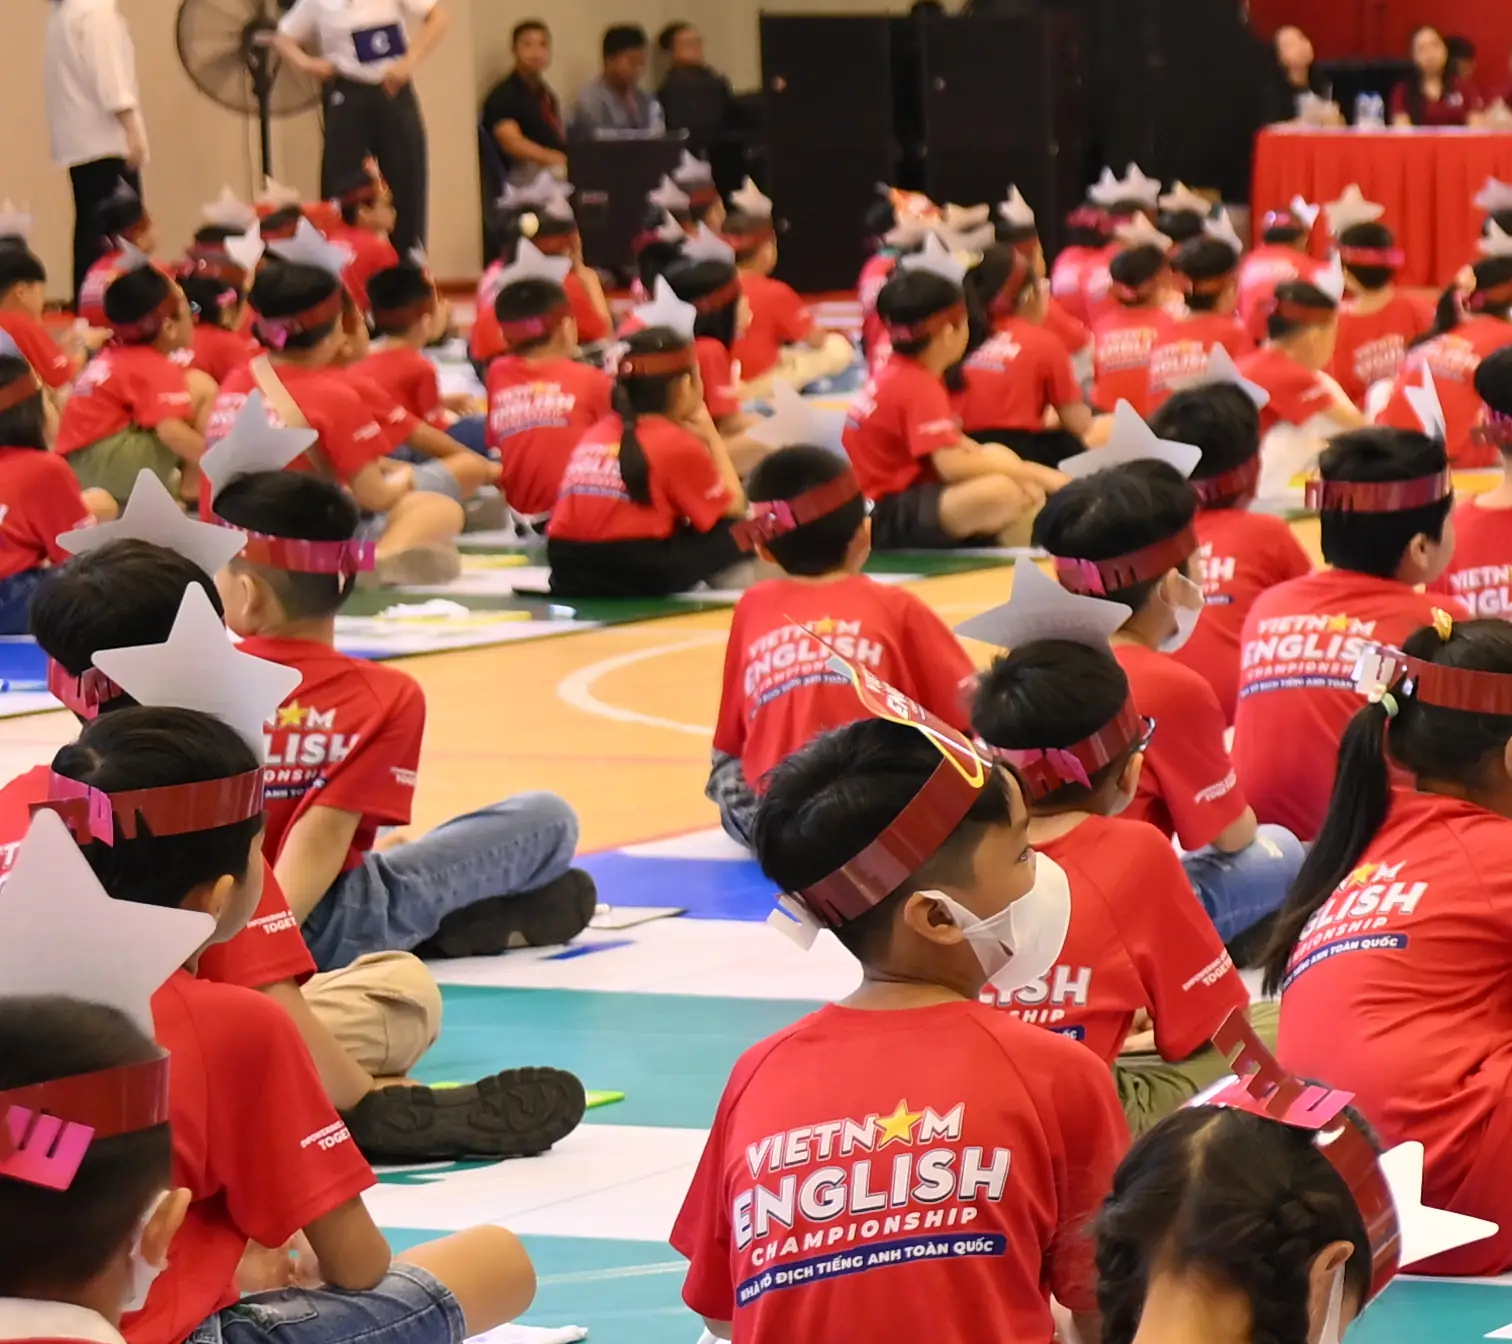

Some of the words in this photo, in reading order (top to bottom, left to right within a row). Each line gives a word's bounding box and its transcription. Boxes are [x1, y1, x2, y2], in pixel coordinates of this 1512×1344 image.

[1244, 633, 1360, 665] ENGLIS
[1330, 938, 1359, 957] TOÀN
[1361, 933, 1398, 950] QUỐC
[733, 1147, 1010, 1251] ENGLISH
[750, 1207, 978, 1267] CHAMPIONSHIP
[815, 1249, 864, 1280] TIẾNG
[868, 1247, 901, 1266] ANH
[904, 1239, 950, 1261] TOÀN
[953, 1232, 995, 1257] QUỐC
